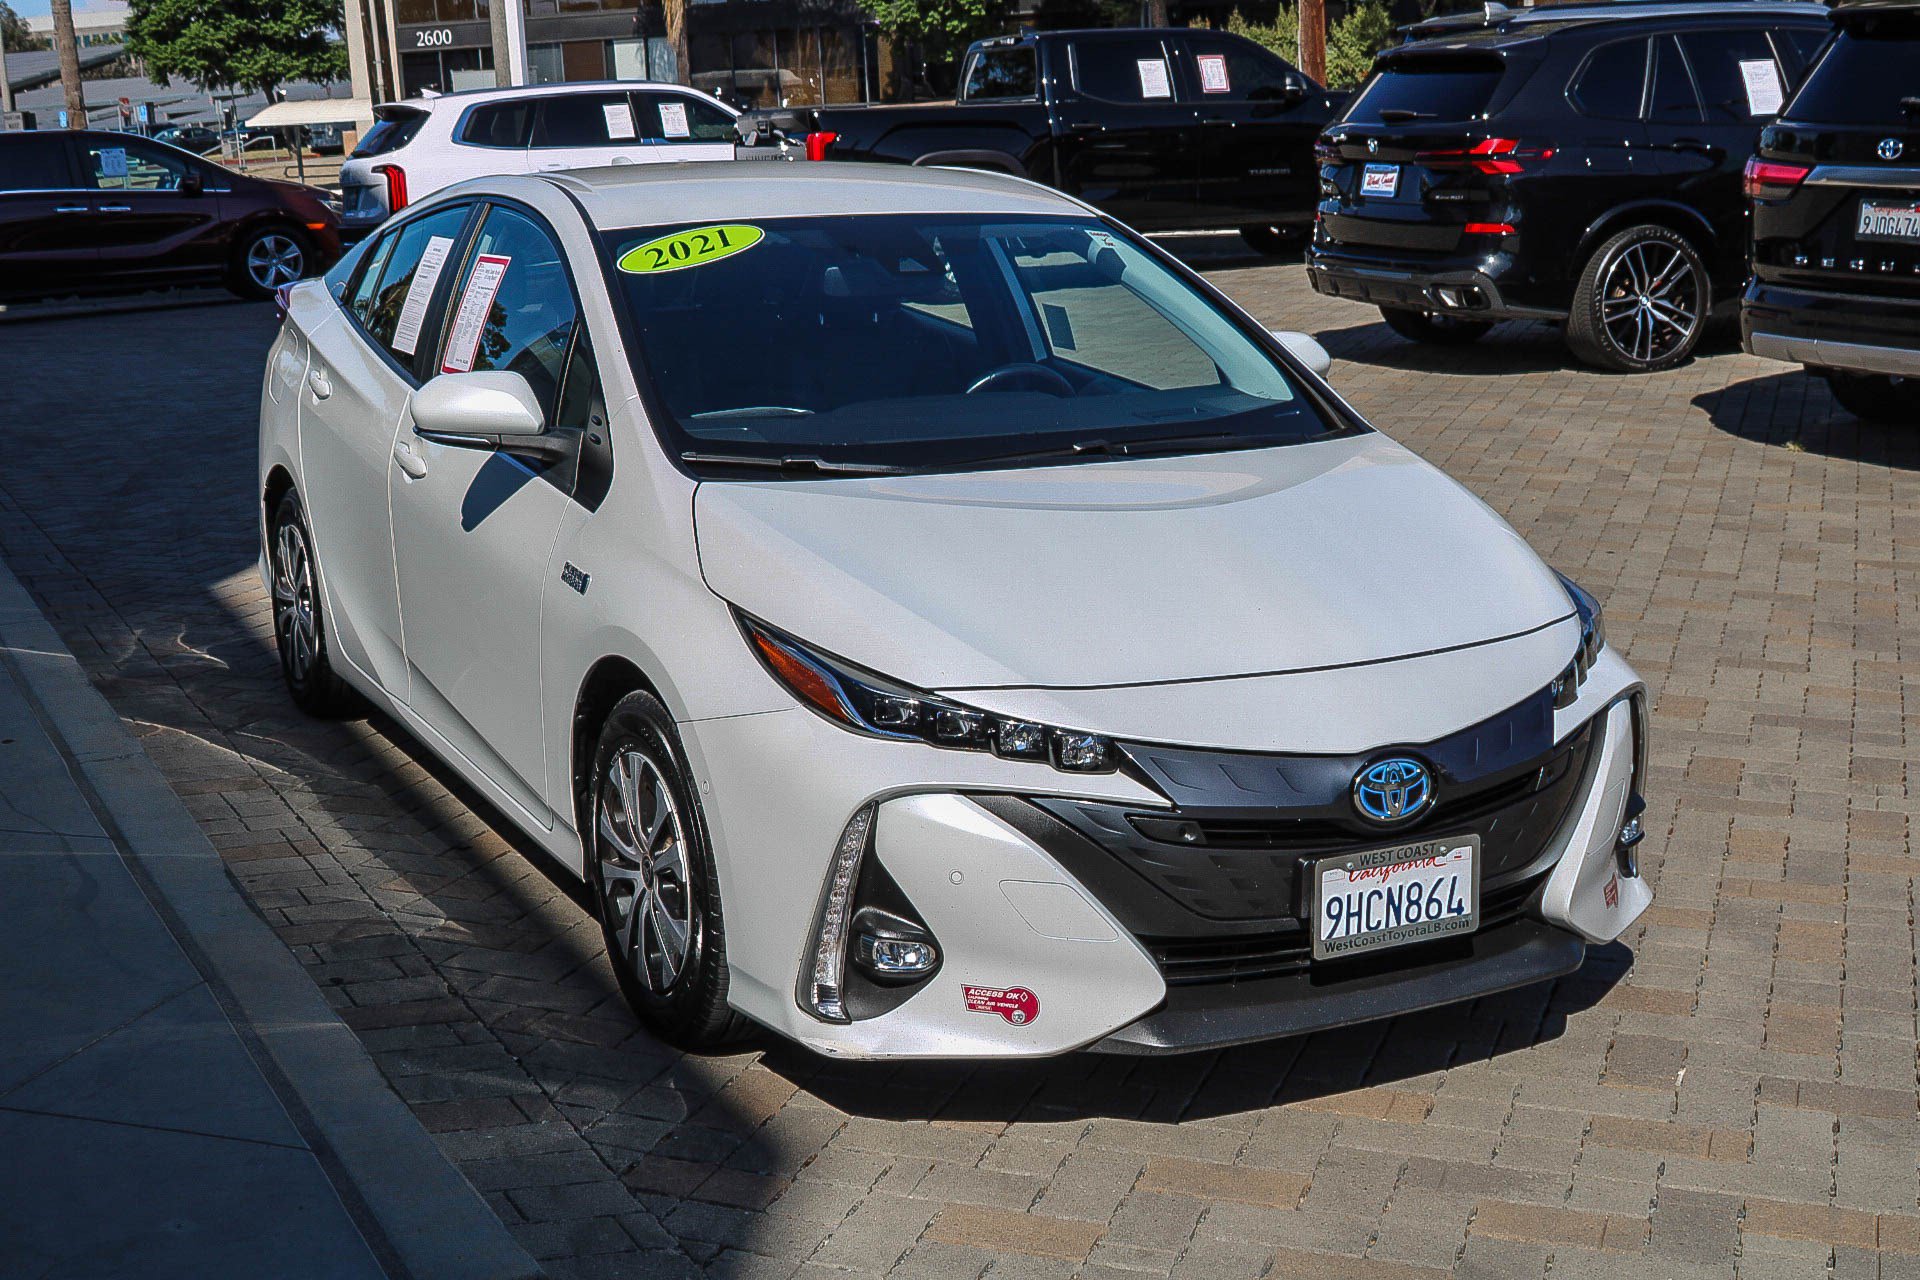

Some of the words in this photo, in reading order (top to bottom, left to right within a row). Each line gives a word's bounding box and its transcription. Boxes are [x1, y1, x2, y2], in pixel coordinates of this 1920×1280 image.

[416, 29, 452, 47] 2600
[645, 229, 732, 269] 2021
[1360, 850, 1394, 867] WEST
[1396, 843, 1437, 860] COAST
[1325, 875, 1465, 939] 9HCN864
[1324, 918, 1470, 953] WestCoastToyotaLB.com
[968, 988, 1004, 998] ACCESS
[1006, 992, 1020, 1000] OK
